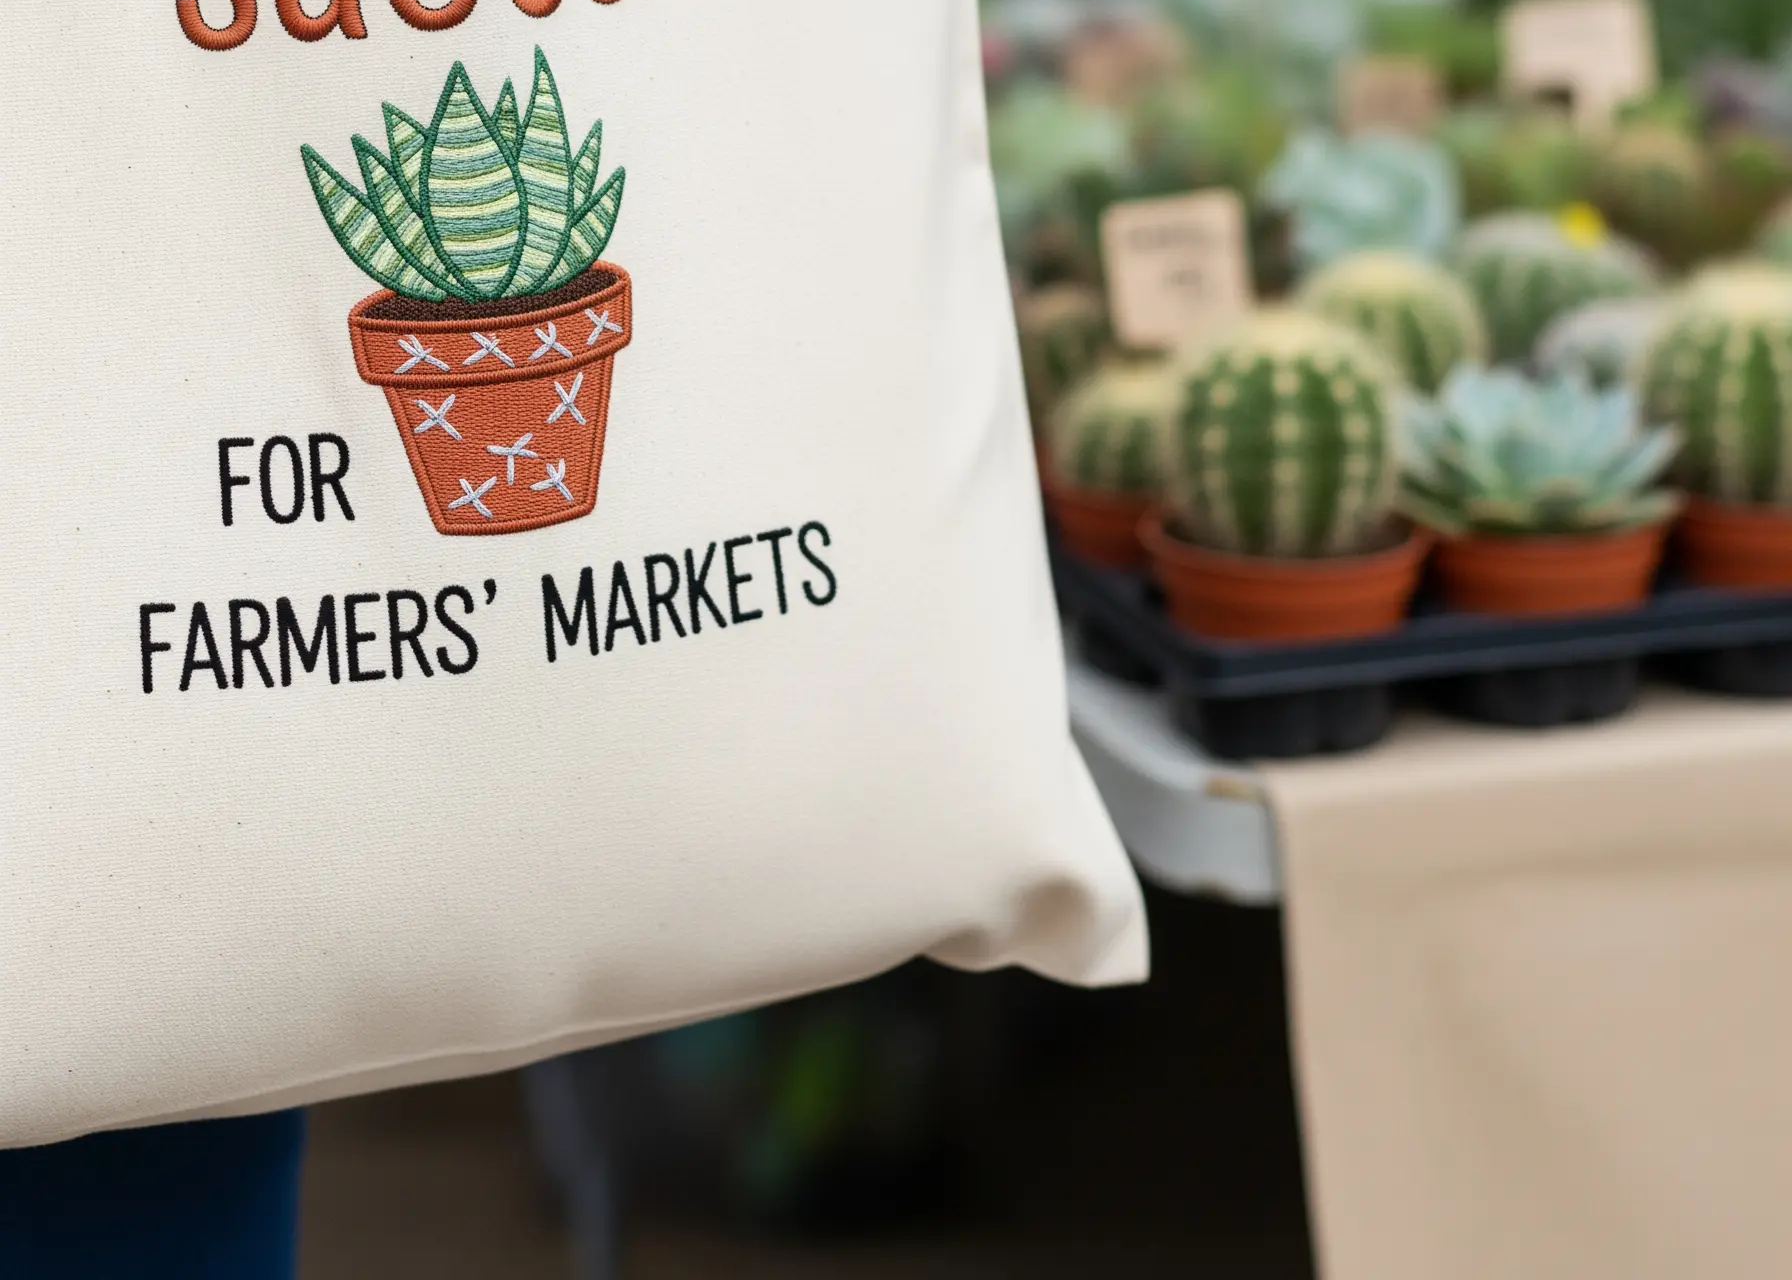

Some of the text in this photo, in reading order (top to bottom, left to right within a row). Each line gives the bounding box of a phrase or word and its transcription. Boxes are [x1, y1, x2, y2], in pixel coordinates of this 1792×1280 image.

[217, 432, 356, 527] FOR
[139, 521, 837, 694] FARMERS’ MARKETS
